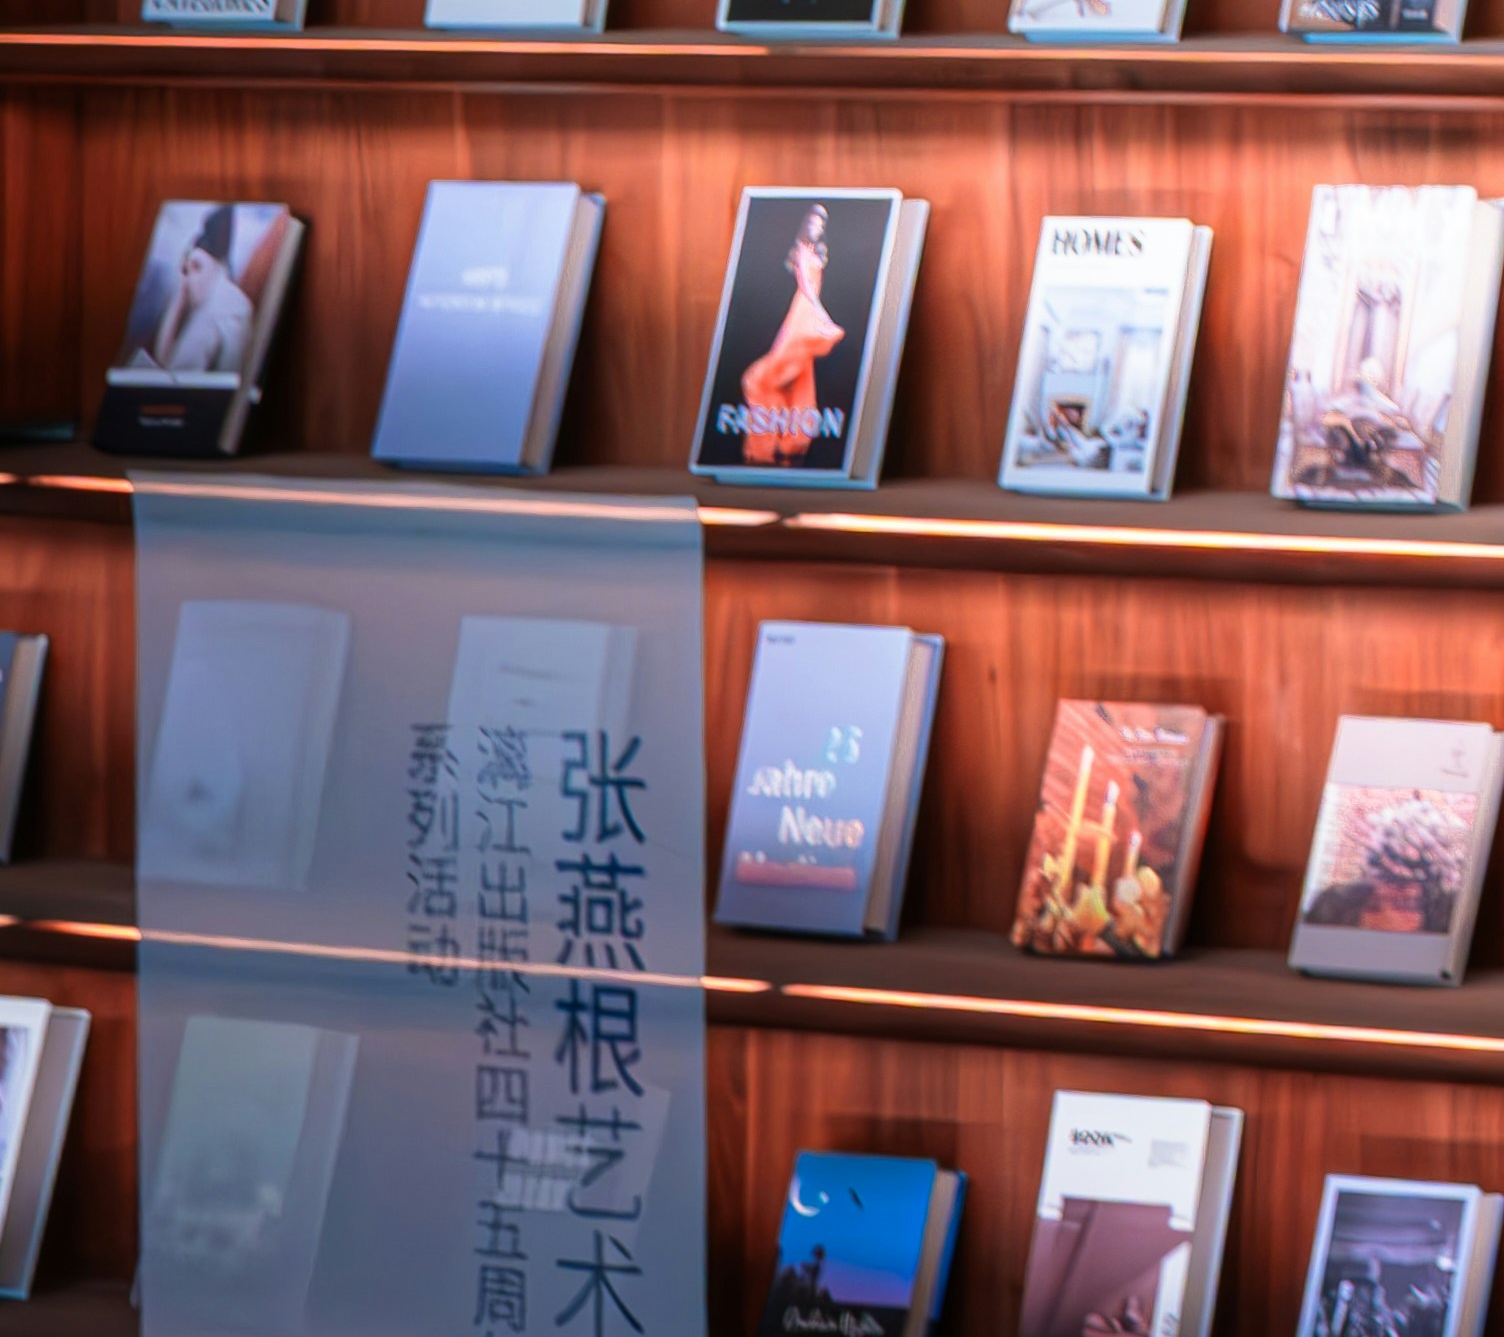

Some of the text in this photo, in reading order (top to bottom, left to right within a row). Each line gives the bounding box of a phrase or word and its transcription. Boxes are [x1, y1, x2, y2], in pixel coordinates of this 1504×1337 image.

[1052, 227, 1146, 257] HOMES
[716, 403, 845, 438] FASHION
[778, 805, 865, 848] Neue
[554, 729, 648, 1337] 张燕根艺术
